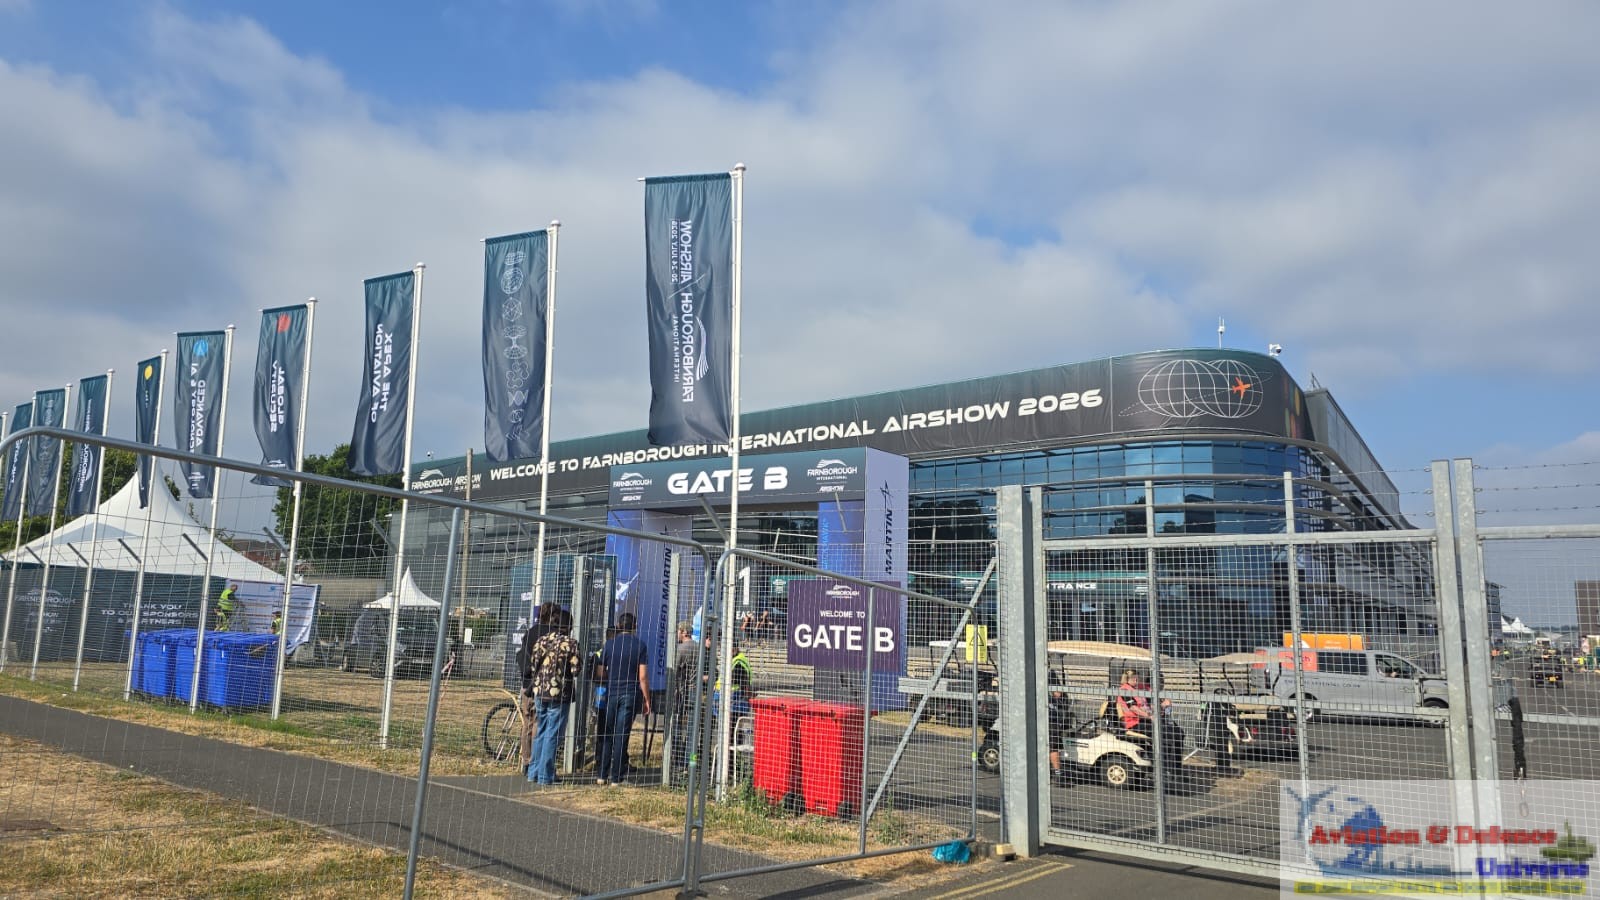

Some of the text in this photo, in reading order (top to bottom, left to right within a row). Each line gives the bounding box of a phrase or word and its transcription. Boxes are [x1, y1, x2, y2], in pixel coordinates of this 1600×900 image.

[490, 460, 556, 482] WELCOME
[560, 457, 580, 473] TO
[582, 444, 708, 470] FARNBOROUGH
[882, 400, 1010, 433] AIRSHOW
[1018, 388, 1104, 416] 2026
[666, 466, 788, 495] GATE B
[807, 466, 858, 476] FARNBOROUGH
[738, 566, 750, 606] 1
[658, 547, 672, 676] LOCKHEED MARTIN
[820, 610, 853, 618] WELCOME
[794, 624, 895, 652] GATE B
